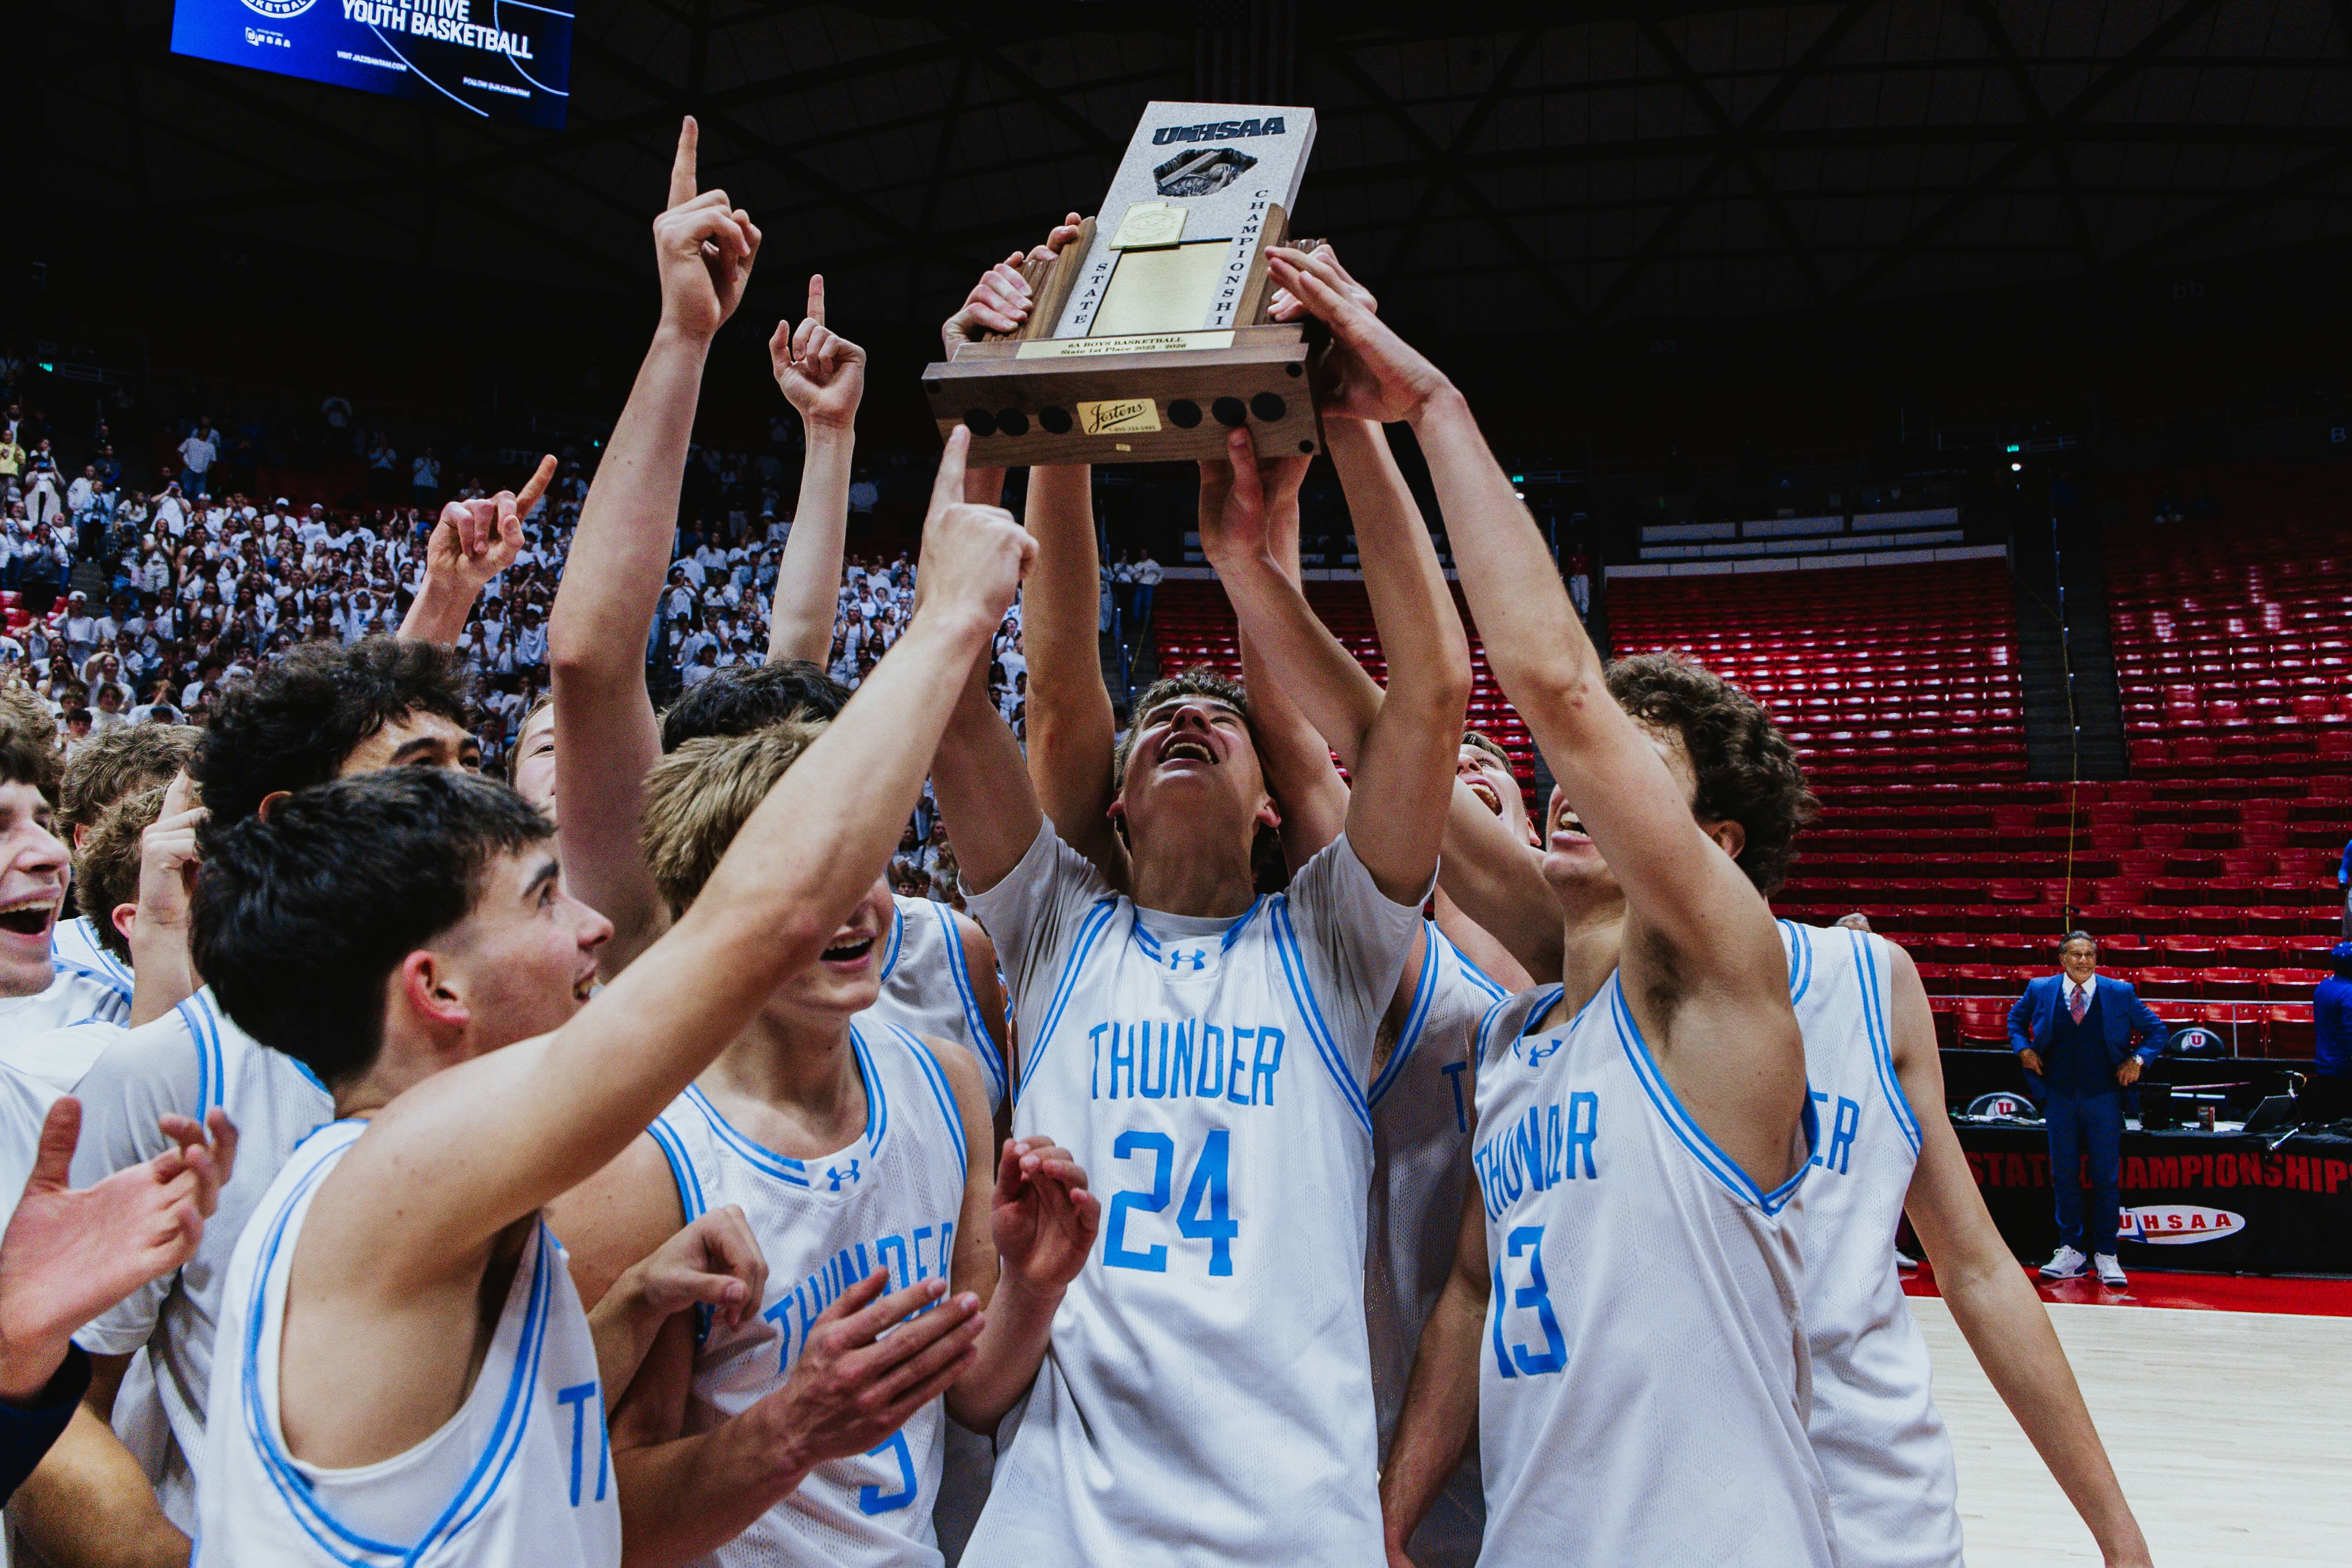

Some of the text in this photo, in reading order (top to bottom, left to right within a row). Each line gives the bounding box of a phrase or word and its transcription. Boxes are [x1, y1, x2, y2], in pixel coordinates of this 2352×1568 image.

[343, 0, 533, 59] YOUTH BASKETBALL
[1152, 117, 1286, 145] UHSAA
[1074, 263, 1109, 323] STATE
[1115, 337, 1183, 346] BASKETBALL
[1088, 403, 1146, 434] Jostens
[2330, 426, 2347, 444] B
[2191, 1035, 2202, 1046] U
[1089, 1018, 1285, 1106] THUNDER
[1998, 1102, 2012, 1115] U
[1474, 1091, 1599, 1223] THUNDR
[1966, 1151, 2054, 1188] STAT
[1103, 1130, 1238, 1277] 24
[2119, 1213, 2233, 1230] UHSAA
[1493, 1225, 1568, 1378] 13
